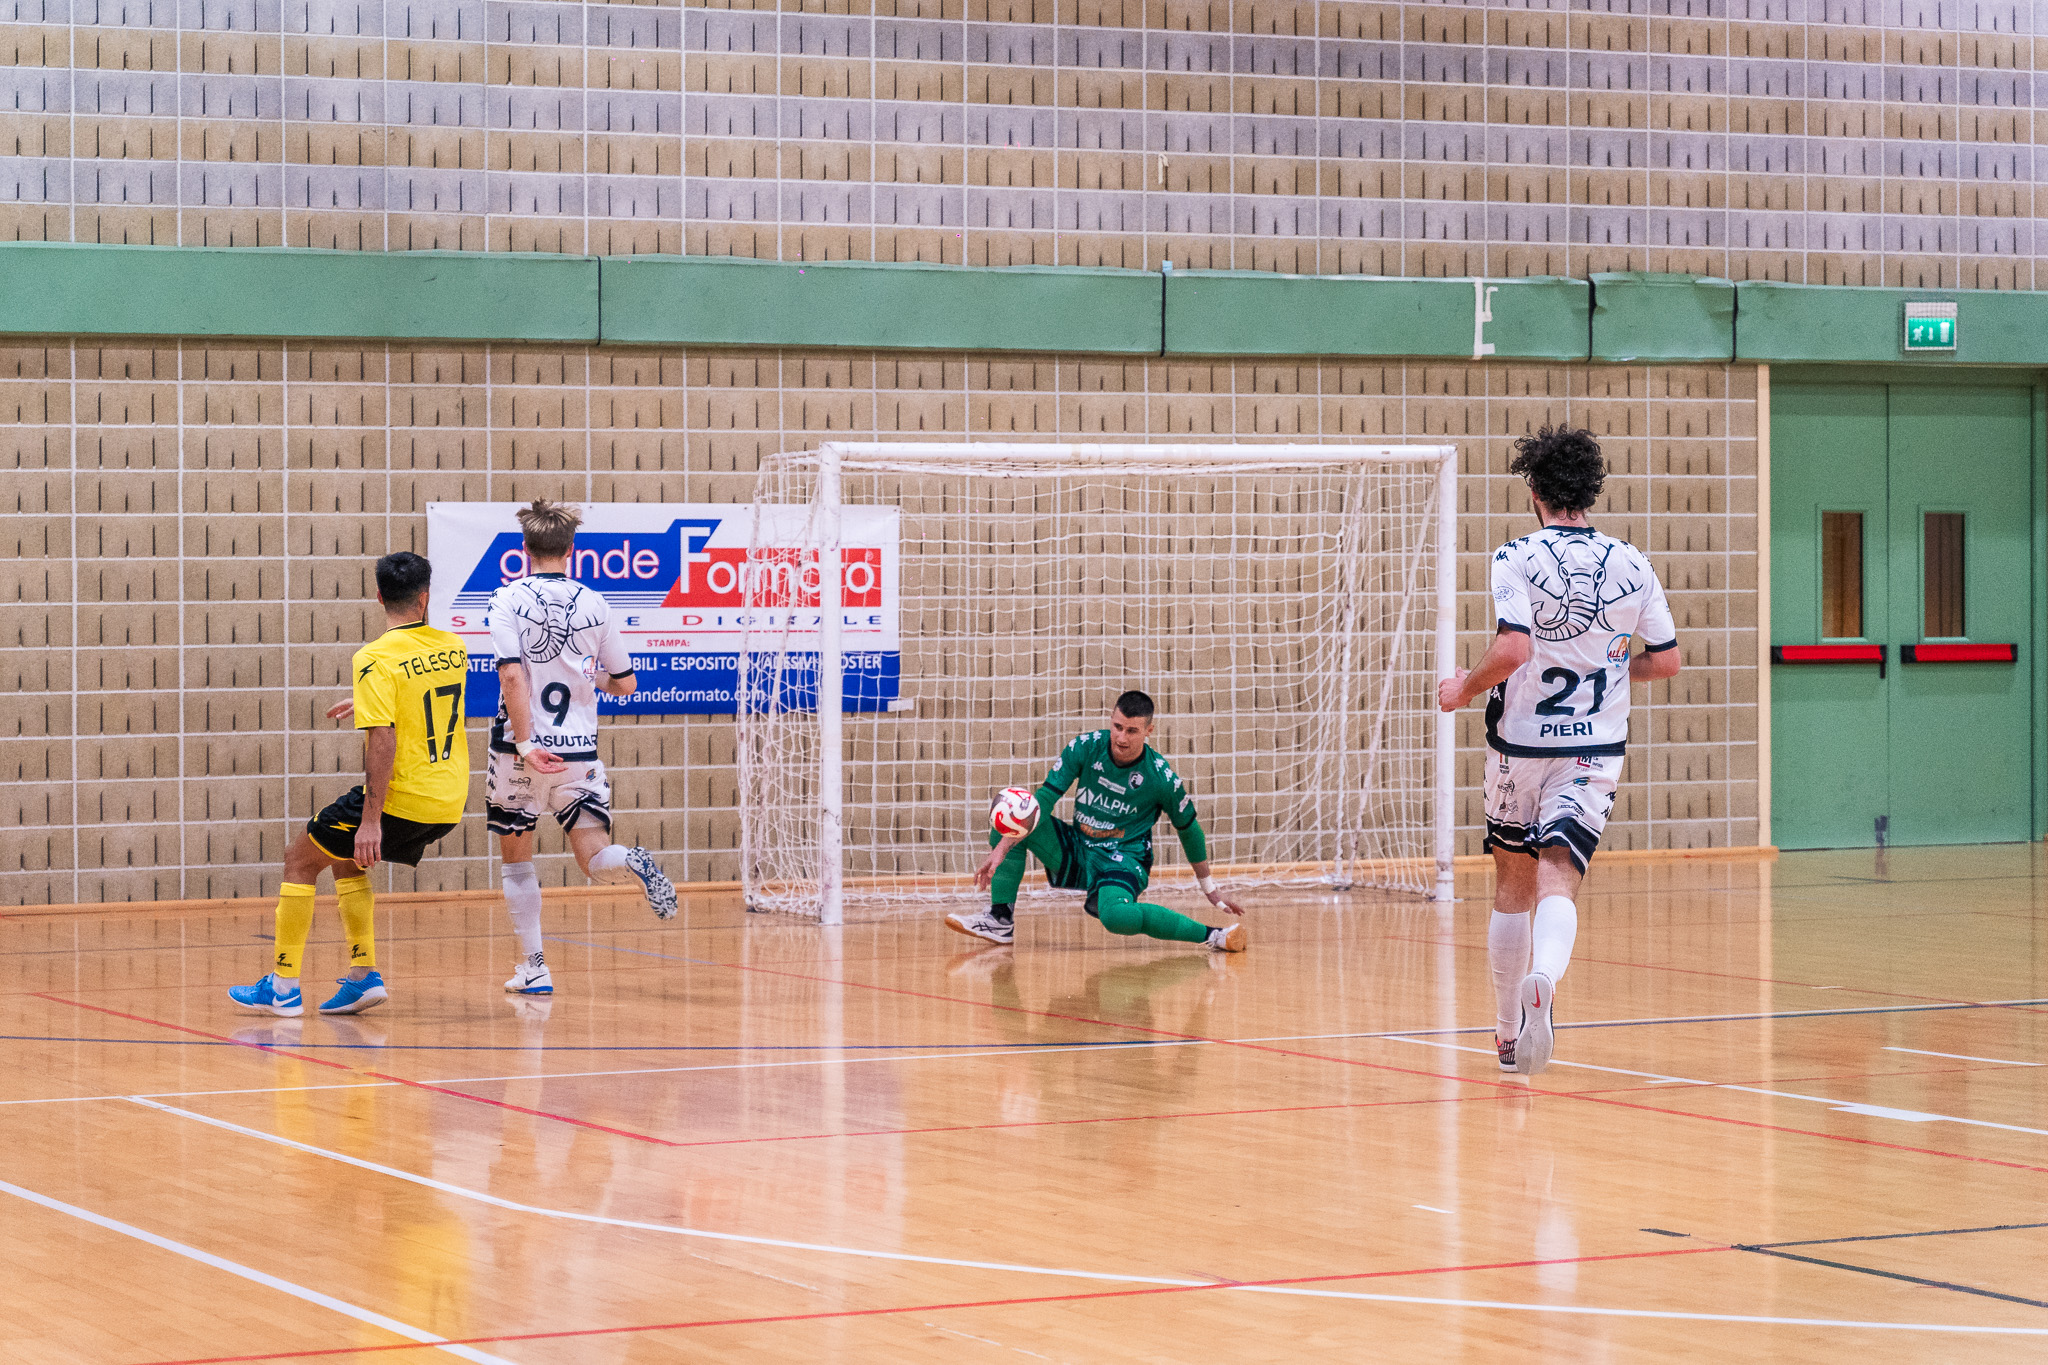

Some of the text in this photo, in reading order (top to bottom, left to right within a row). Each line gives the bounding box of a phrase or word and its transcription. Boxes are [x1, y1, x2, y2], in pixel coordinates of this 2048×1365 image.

[500, 527, 875, 594] gnde Formao
[646, 639, 690, 648] STAMPA:
[840, 655, 881, 669] OSTER
[541, 682, 571, 727] 9
[1535, 666, 1607, 716] 21
[423, 683, 461, 764] 17
[1540, 722, 1593, 737] PIERI
[1093, 793, 1138, 815] ALPHA
